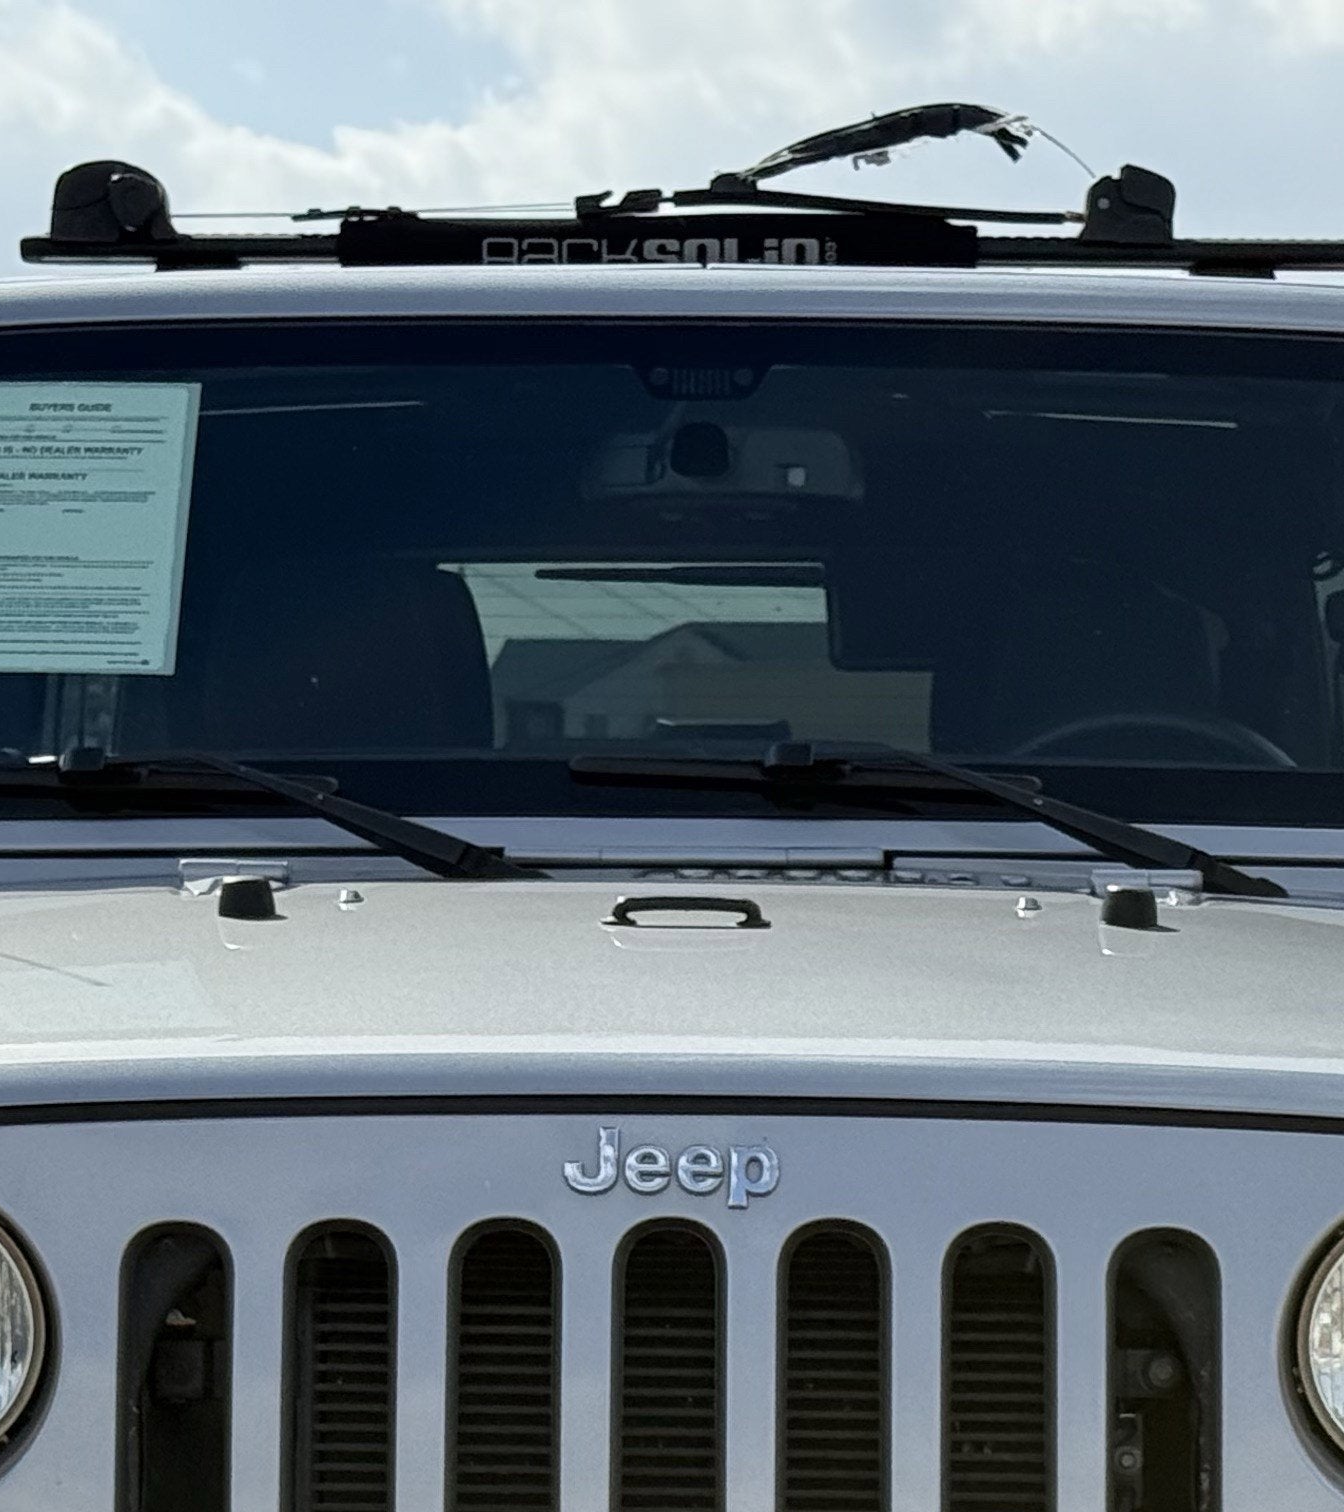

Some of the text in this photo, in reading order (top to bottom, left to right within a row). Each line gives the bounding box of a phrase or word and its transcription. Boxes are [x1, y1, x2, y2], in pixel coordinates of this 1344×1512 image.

[29, 403, 112, 412] BUYERS GUIDE
[39, 446, 81, 455] DEALER
[83, 447, 144, 456] WARRANTY
[563, 1126, 780, 1209] Jeep
